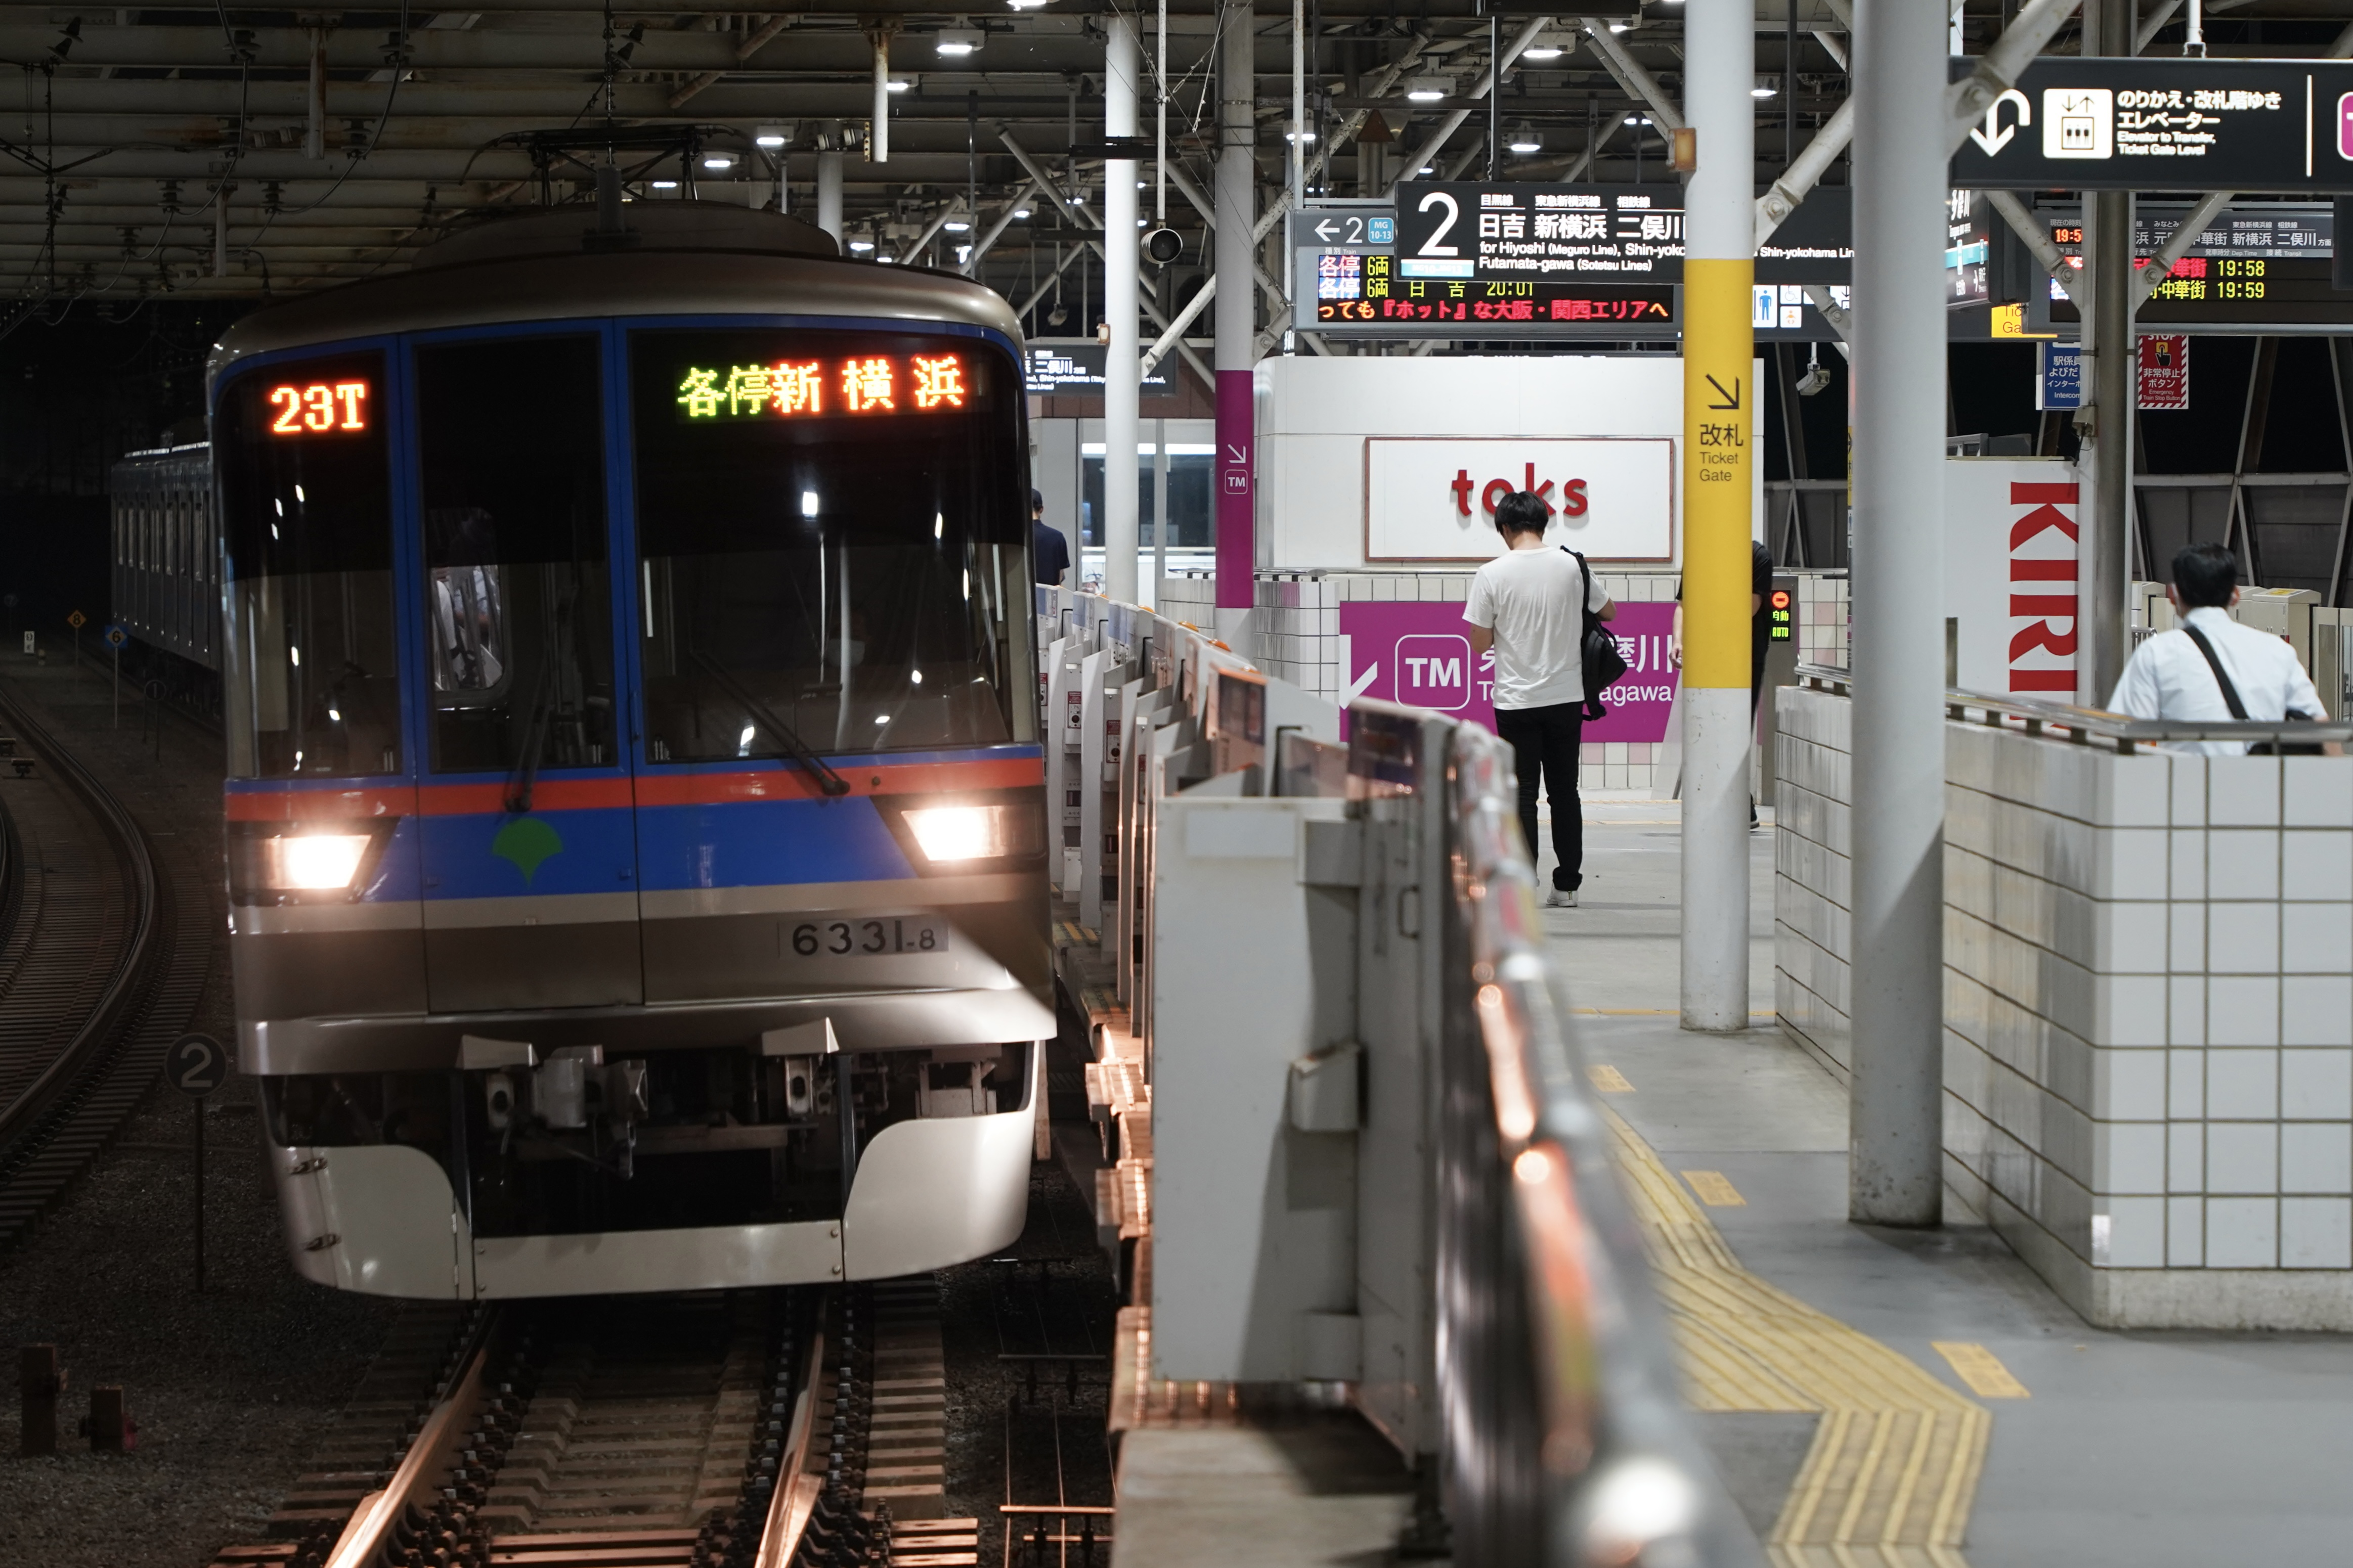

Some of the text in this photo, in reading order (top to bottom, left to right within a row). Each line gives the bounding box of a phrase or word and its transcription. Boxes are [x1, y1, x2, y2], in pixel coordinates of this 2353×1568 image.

[2117, 90, 2282, 110] のりかえ・改札階ゆき
[2117, 111, 2220, 130] エレベーター
[2117, 131, 2216, 145] Elevator to Transfer,
[2117, 144, 2205, 155] Ticket Gate Level
[1480, 194, 1651, 208] 目黒線 東急新横浜線 相鉄線
[1345, 216, 1363, 243] 2
[1418, 192, 1459, 256] 2
[1479, 213, 1686, 240] 日吉 新横浜 二俣川
[1370, 231, 1391, 240] 10-13
[2056, 229, 2082, 242] 19:5
[2136, 232, 2149, 245] 浜
[2232, 233, 2272, 246] 新横浜
[2277, 233, 2317, 247] 二俣川
[1480, 241, 1686, 259] for Hiyoshi (Meguro Line), Shin-yoko
[1760, 246, 1855, 259] Shin-yokohama Lin
[1319, 255, 1388, 276] 各停 6両
[1479, 256, 1652, 272] Futamata-gawa (Sotetsu Lines)
[2218, 260, 2265, 277] 19:58
[1319, 278, 1360, 298] 各停
[1367, 278, 1388, 297] 6両
[1487, 282, 1533, 296] 20:01
[2217, 282, 2265, 299] 19:59
[2003, 304, 2022, 317] Tic
[2002, 321, 2022, 334] Ga
[2143, 368, 2181, 378] 非常停止
[677, 355, 965, 417] 各停 新横浜
[2148, 379, 2175, 388] ボタン
[271, 383, 365, 432] 23T
[1700, 423, 1744, 447] 改札
[1700, 452, 1739, 464] Ticket
[1228, 477, 1246, 487] TM
[1700, 469, 1732, 481] Gate
[1452, 462, 1588, 516] toks
[2009, 481, 2080, 731] KIRI
[73, 614, 80, 625] 8
[1772, 610, 1789, 621] 自動
[112, 631, 121, 643] 6
[1772, 627, 1789, 638] AUTO
[1405, 658, 1461, 688] TM
[1598, 685, 1672, 707] agawa
[181, 1042, 213, 1088] 2
